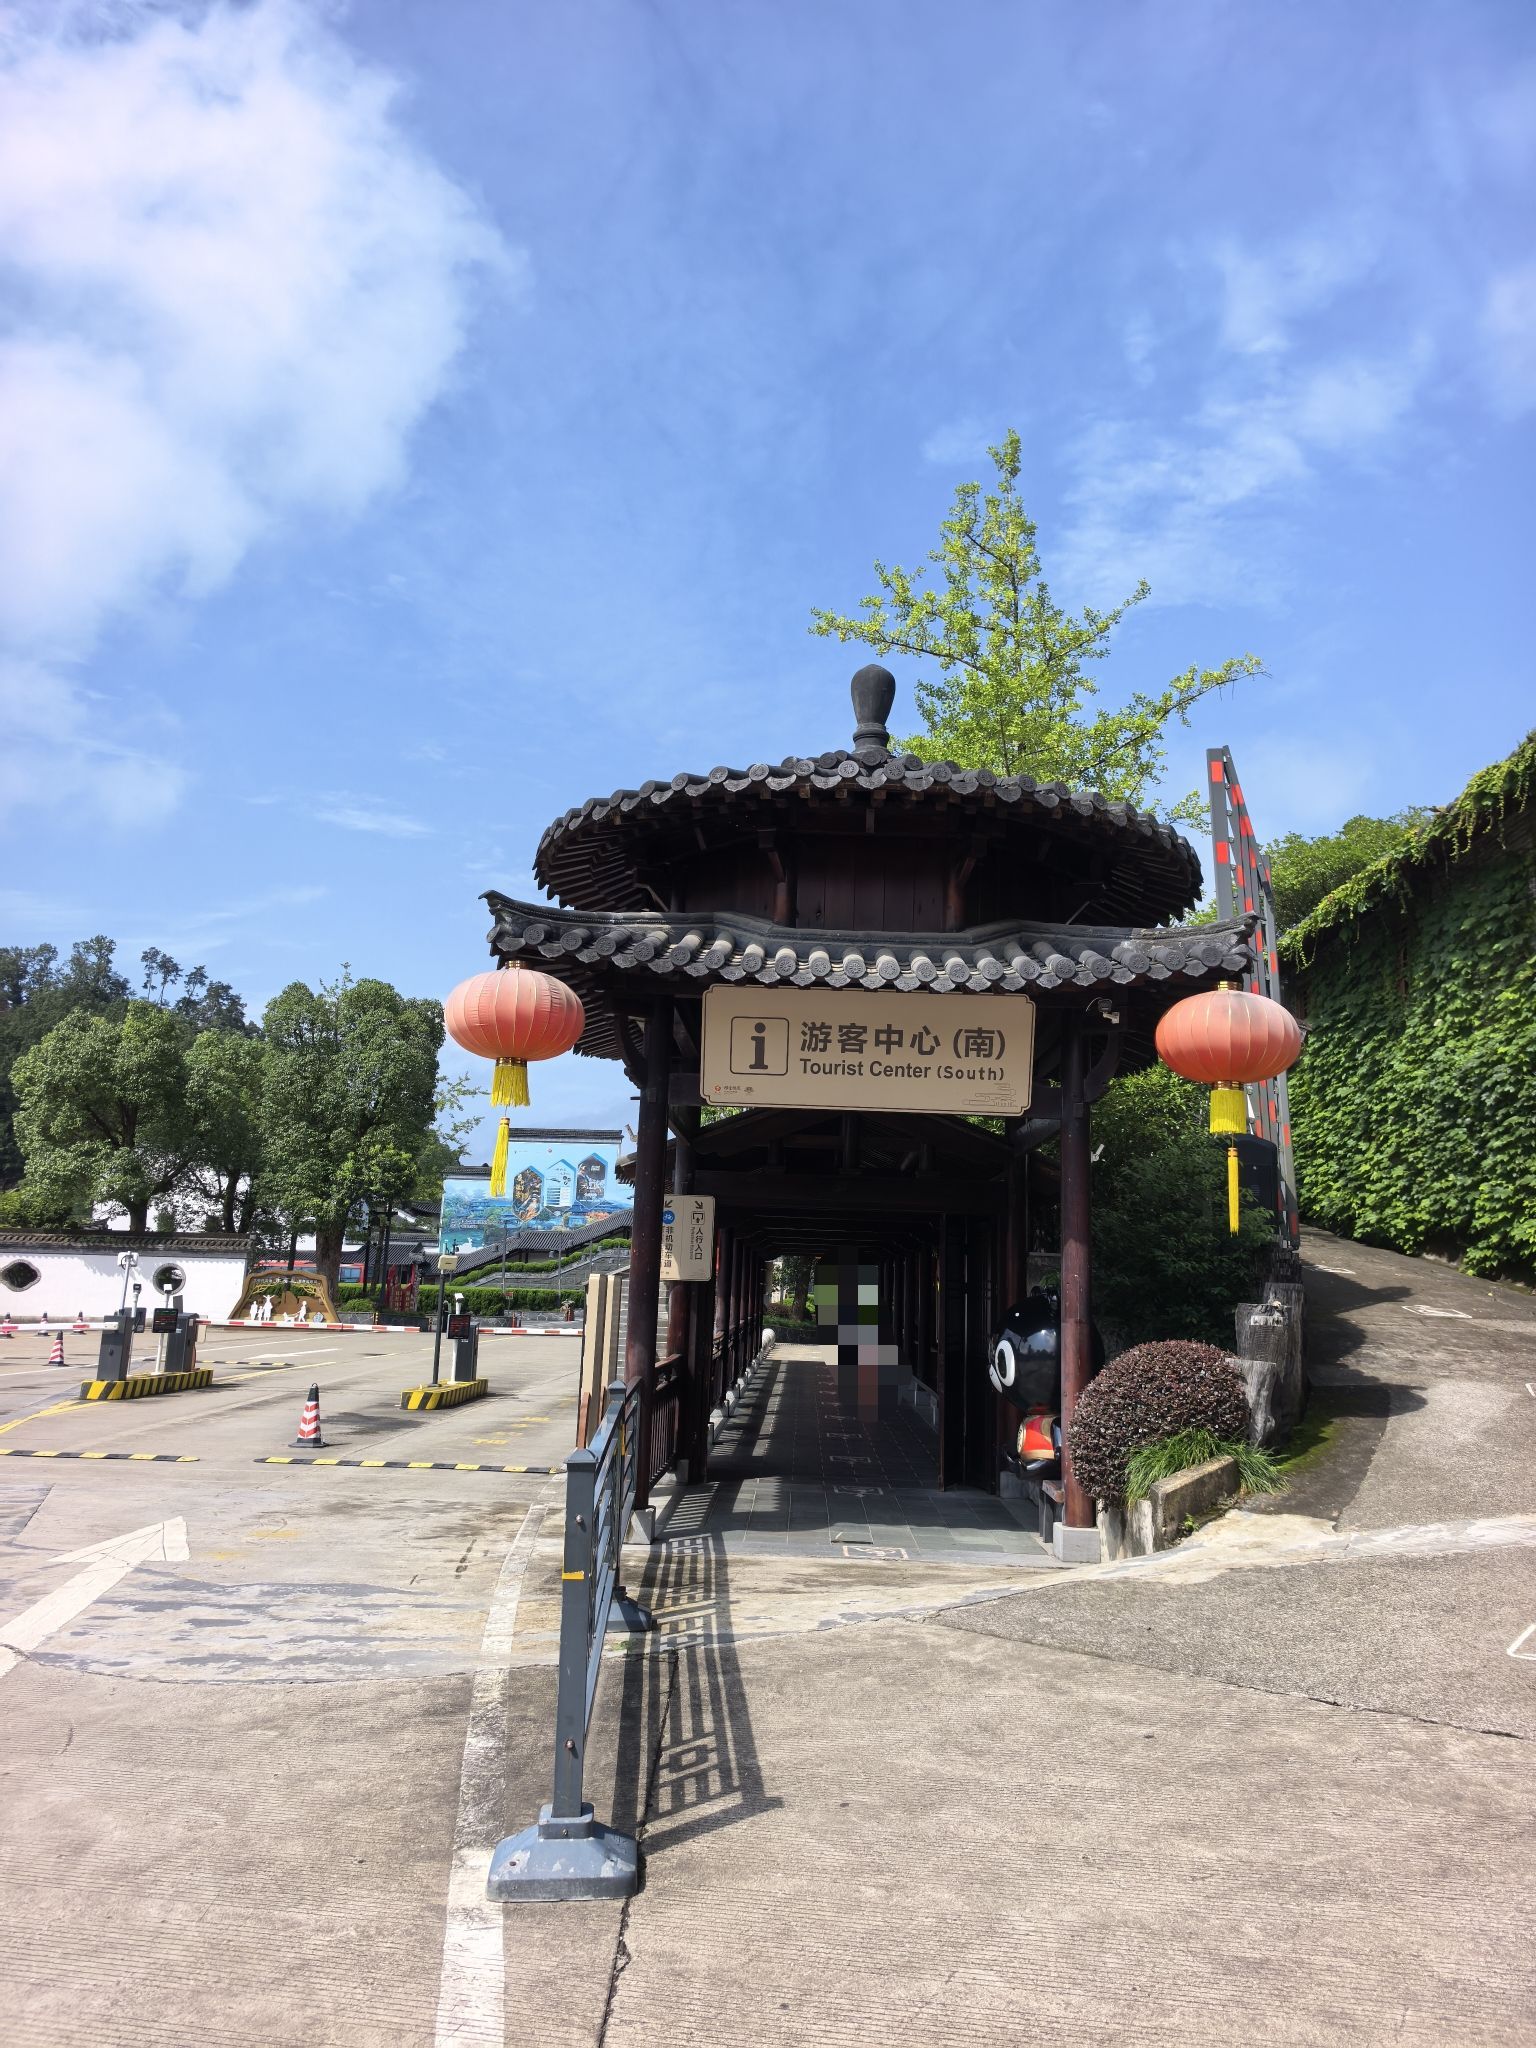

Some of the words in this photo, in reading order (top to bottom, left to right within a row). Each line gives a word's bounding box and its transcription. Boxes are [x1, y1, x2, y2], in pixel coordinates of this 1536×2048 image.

[800, 1058, 864, 1076] Tourist
[869, 1061, 931, 1079] Center
[937, 1065, 1005, 1081] (South)
[664, 1227, 674, 1267] 非机动车道
[695, 1227, 703, 1260] 人行入口
